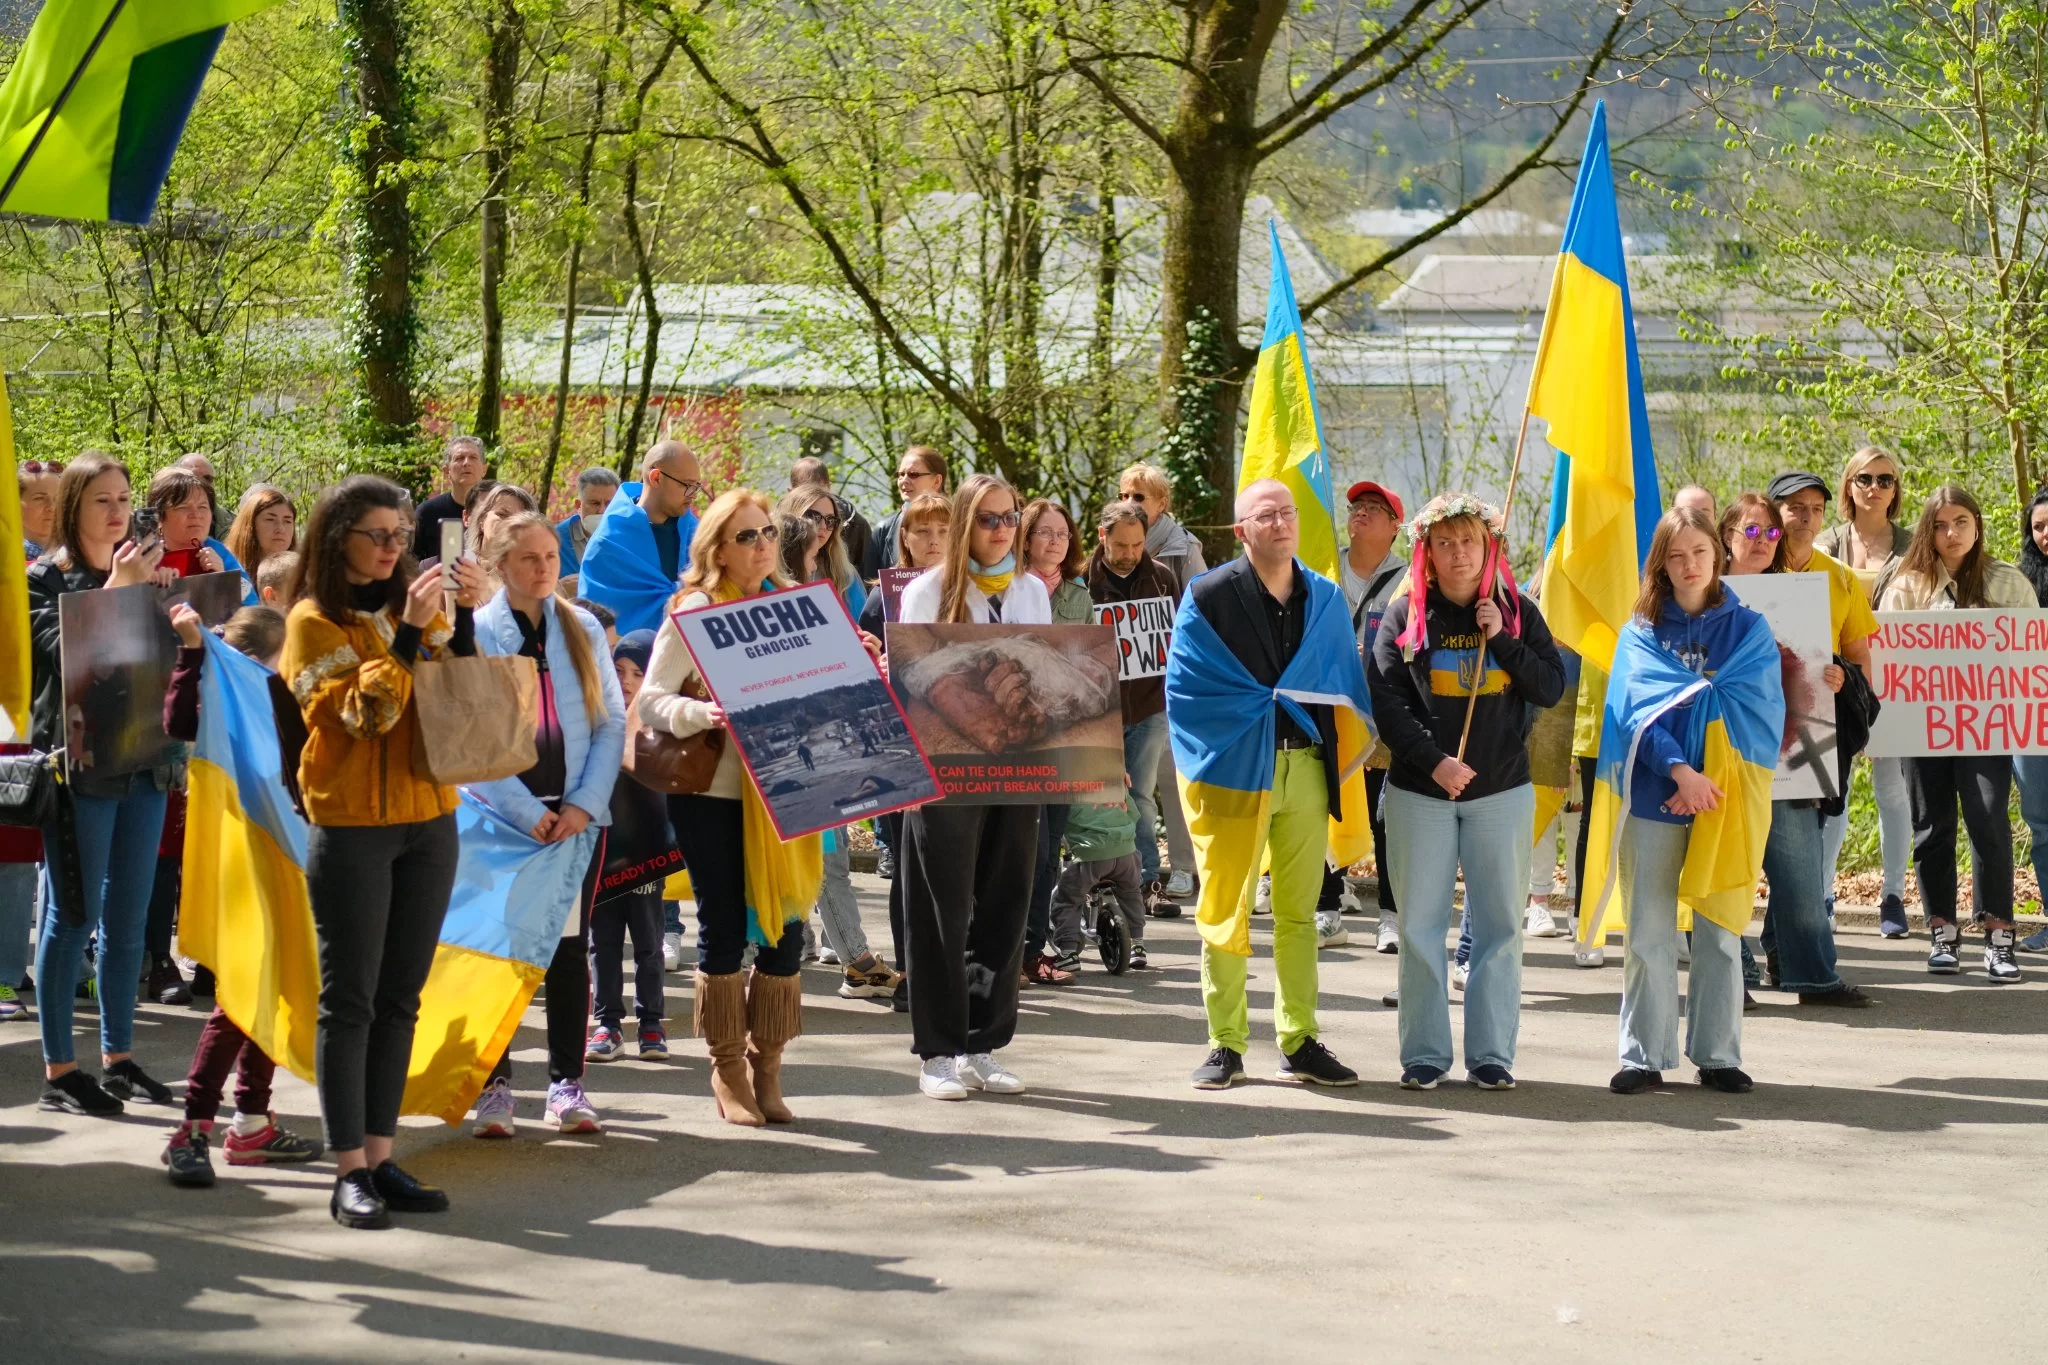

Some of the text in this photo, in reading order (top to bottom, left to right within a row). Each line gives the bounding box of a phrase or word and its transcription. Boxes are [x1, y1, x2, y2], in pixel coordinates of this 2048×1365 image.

[701, 595, 829, 650] BUCHA
[1126, 599, 1174, 634] PUTIN
[745, 633, 812, 659] GENOCIDE
[740, 682, 764, 693] NEVER
[796, 668, 820, 680] NEVER
[939, 765, 965, 777] CAN
[967, 765, 985, 777] TIE
[987, 765, 1014, 777] OUR
[1016, 765, 1058, 777] HANDS
[965, 781, 1001, 793] CAN'T
[1003, 781, 1043, 793] BREAK
[1044, 780, 1070, 793] OUR
[1072, 780, 1106, 793] SPIRIT
[604, 864, 646, 889] READY
[647, 855, 667, 870] TO
